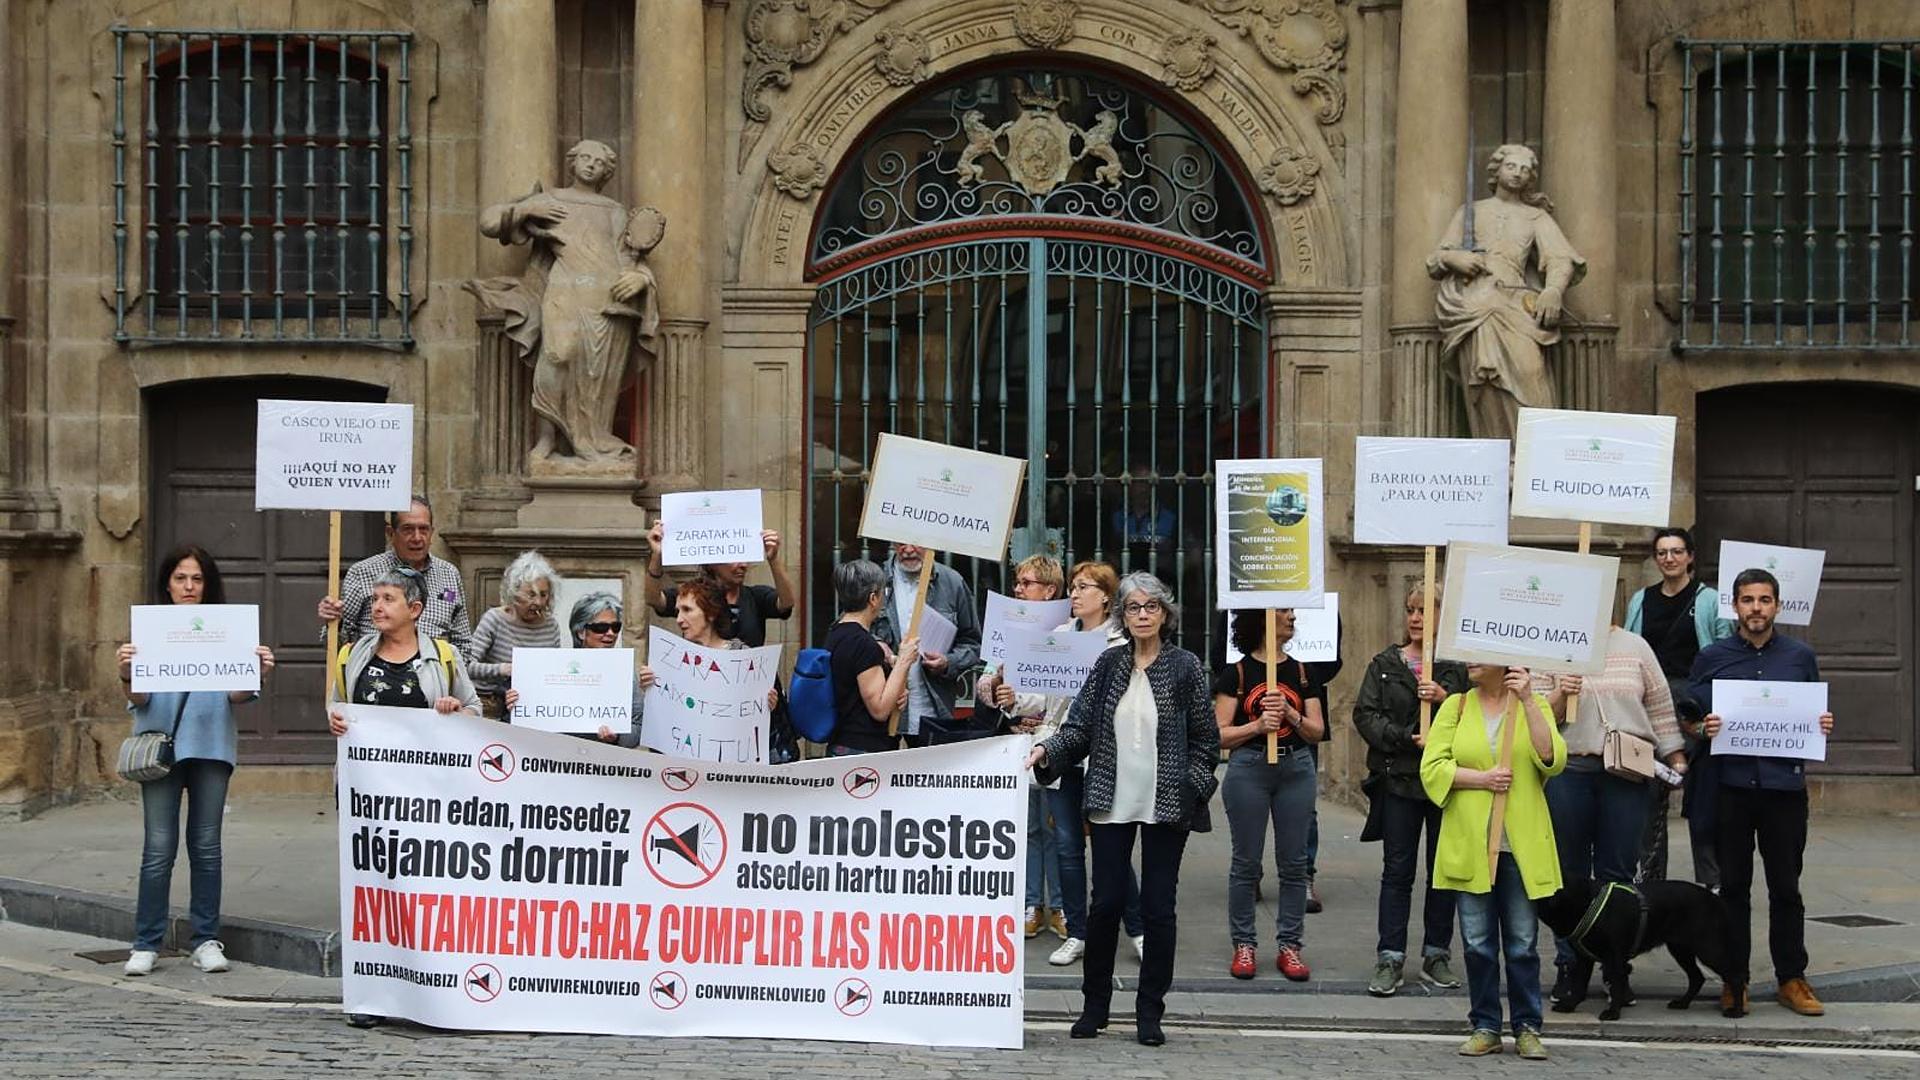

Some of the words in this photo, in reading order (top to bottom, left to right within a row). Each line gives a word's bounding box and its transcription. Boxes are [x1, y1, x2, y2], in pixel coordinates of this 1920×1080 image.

[773, 210, 793, 265] PATET
[817, 78, 884, 147] OMNIBUS
[942, 25, 999, 49] JANVA
[1100, 25, 1137, 48] COR
[1219, 92, 1264, 142] VALDE
[281, 416, 330, 428] CASCO
[334, 418, 376, 429] VIEJO
[380, 420, 401, 430] DE
[319, 432, 363, 444] IRUÑA
[342, 463, 363, 474] NO
[367, 464, 397, 474] HAY
[288, 476, 334, 489] QUIEN
[1371, 473, 1425, 484] BARRIO
[1381, 489, 1427, 502] ¿PARA
[1430, 488, 1483, 502] QUIÉN?
[1531, 478, 1550, 492] EL
[1554, 480, 1604, 496] RUIDO
[1608, 485, 1650, 499] MATA
[881, 502, 898, 516] EL
[902, 506, 949, 525] RUIDO
[952, 515, 990, 533] MATA
[676, 529, 729, 541] ZARATAK
[733, 527, 751, 539] HIL
[680, 546, 724, 557] EGITEN
[728, 544, 745, 554] DU
[1780, 600, 1810, 612] MATA
[1461, 618, 1481, 633] EL
[1485, 621, 1540, 640] RUIDO
[1544, 628, 1588, 645] MATA
[1297, 640, 1333, 651] MATA
[660, 638, 769, 684] ZARATAK
[1017, 662, 1072, 675] ZARATAK
[135, 664, 154, 677] EL
[159, 663, 210, 676] RUIDO
[215, 663, 256, 676] MATA
[1020, 677, 1066, 689] EGITEN
[514, 705, 530, 718] EL
[535, 705, 584, 718] RUIDO
[588, 706, 627, 718] MATA
[1728, 721, 1788, 733] ZARATAK
[1793, 724, 1813, 733] HIL
[1730, 736, 1781, 748] EGITEN
[1785, 738, 1805, 749] DU
[348, 746, 472, 768] ALDEZAHARREANBIZI
[521, 757, 652, 778] CONVIVIRENLOVIEJO
[890, 773, 1018, 790] ALDEZAHARREANBIZI
[350, 787, 441, 823] barruan
[446, 796, 514, 831] edan,
[520, 802, 631, 834] mesedez
[741, 812, 798, 854] no
[809, 809, 1016, 860] molestes
[352, 826, 491, 880] déjanos
[500, 837, 629, 886] dormir
[737, 860, 829, 892] atseden
[835, 862, 897, 894] hartu
[902, 864, 953, 896] nahi
[958, 864, 1015, 900] dugu
[658, 902, 803, 968] CUMPLIR
[811, 910, 870, 970] LAS
[878, 912, 1015, 974] NORMAS
[353, 961, 458, 988] ALDEZAHARREANBIZI
[508, 976, 640, 997] CONVIVIRENLOVIEJO
[695, 984, 826, 1004] CONVIVIRENLOVIEJO
[882, 989, 1012, 1008] ALDEZAHARREANBIZI
